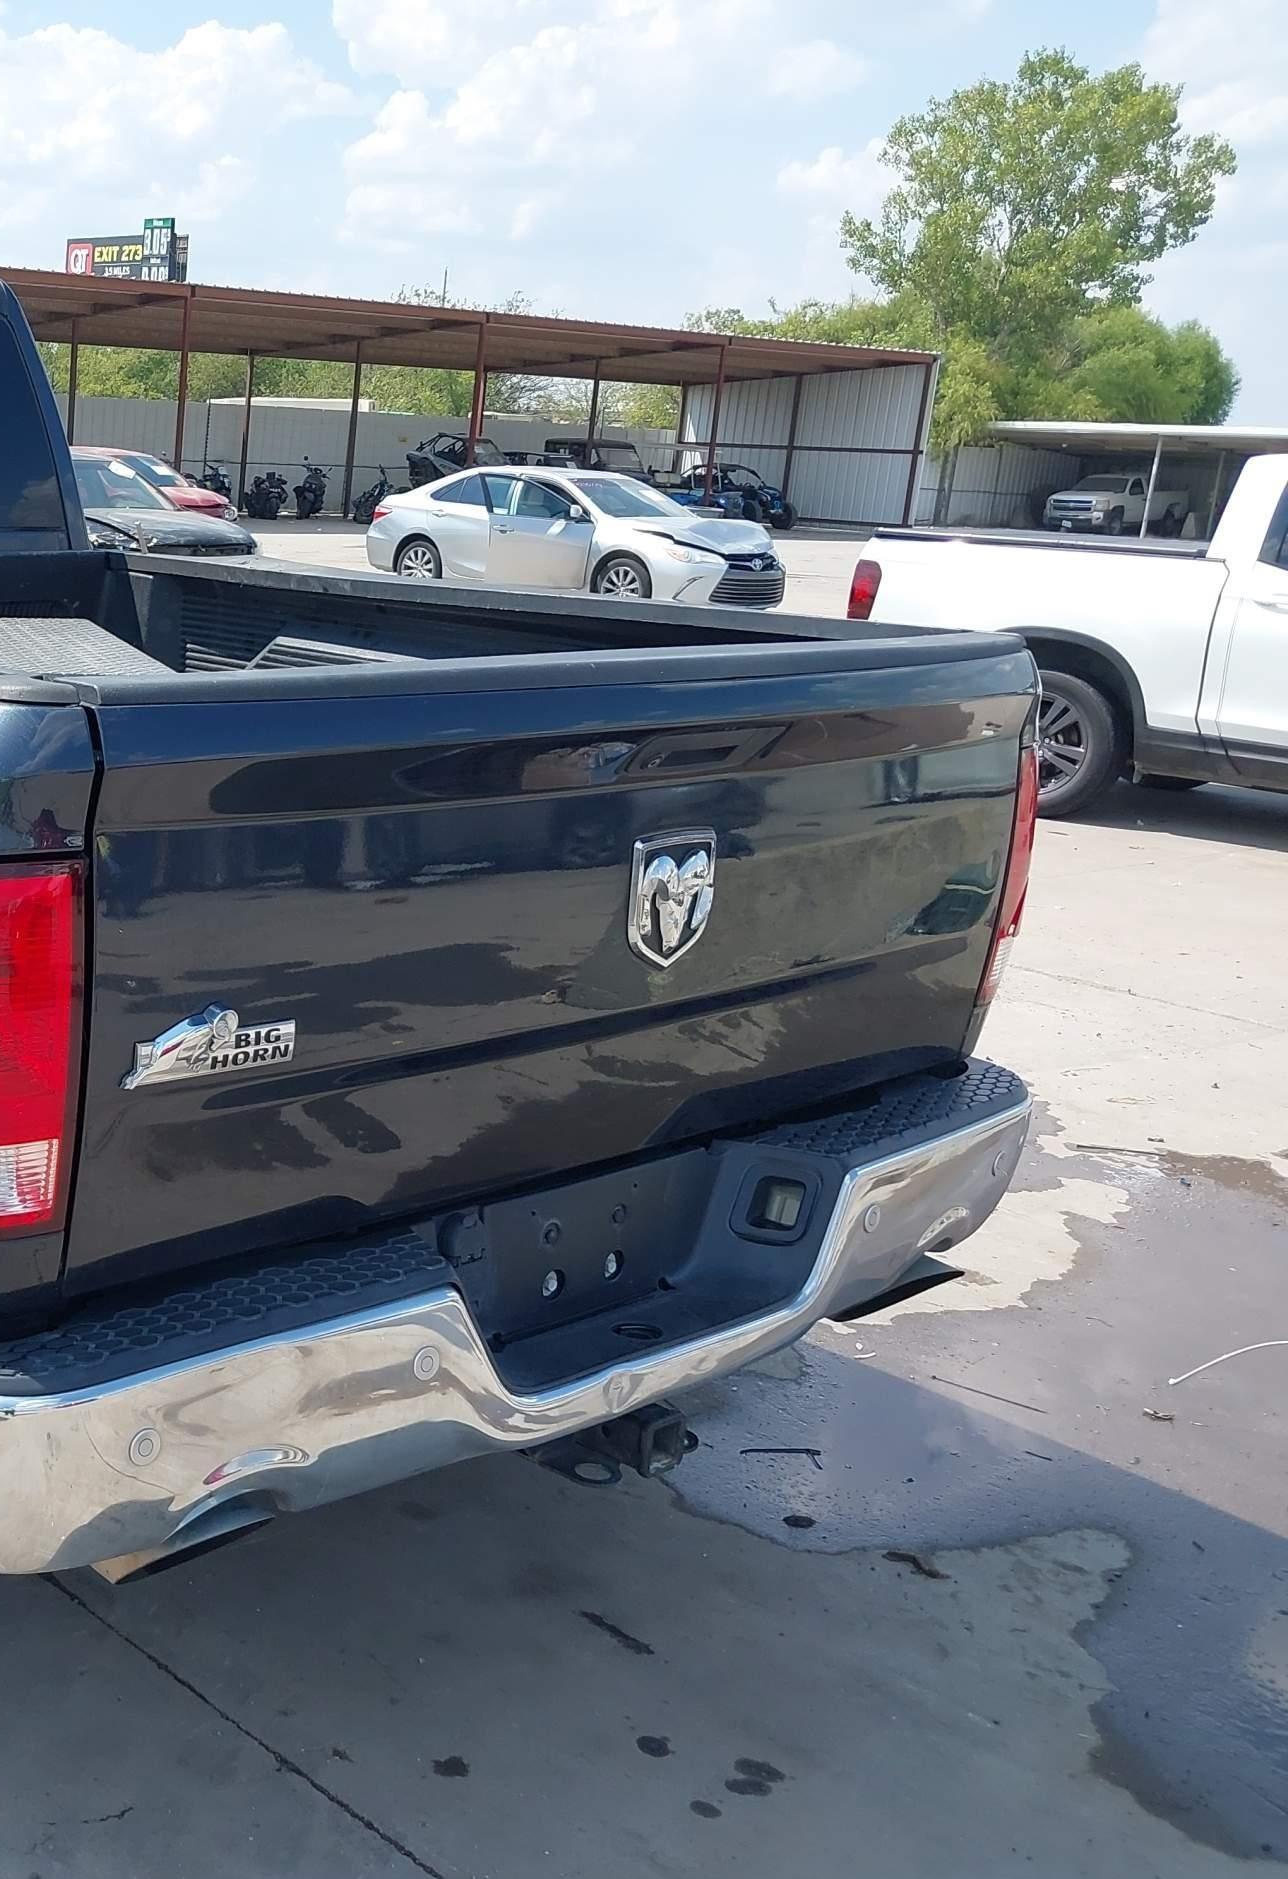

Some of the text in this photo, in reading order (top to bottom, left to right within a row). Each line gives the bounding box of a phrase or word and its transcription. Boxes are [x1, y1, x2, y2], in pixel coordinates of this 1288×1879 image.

[70, 249, 89, 275] QT
[94, 246, 118, 262] EXIT
[121, 244, 143, 261] 273
[113, 266, 130, 275] MILES
[234, 1027, 282, 1049] BIG
[209, 1043, 290, 1070] HORN
